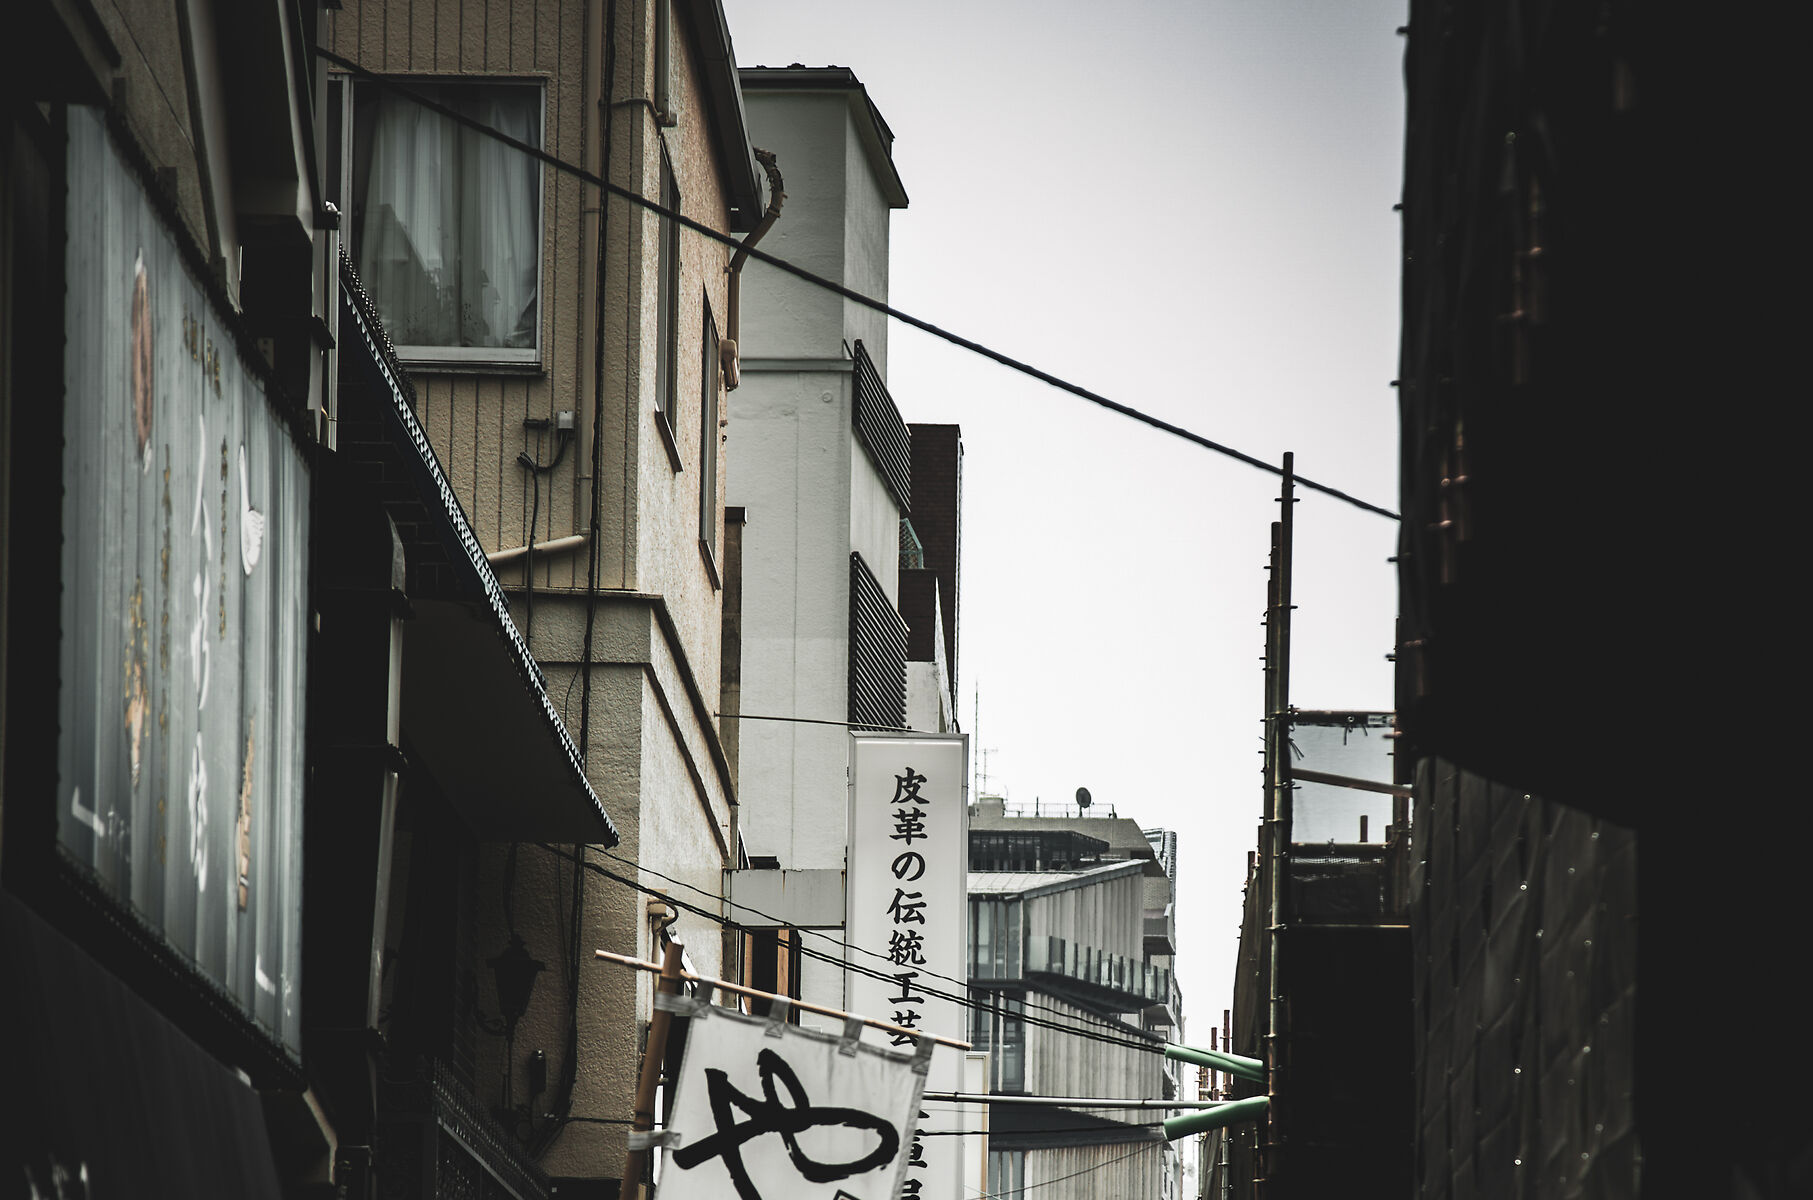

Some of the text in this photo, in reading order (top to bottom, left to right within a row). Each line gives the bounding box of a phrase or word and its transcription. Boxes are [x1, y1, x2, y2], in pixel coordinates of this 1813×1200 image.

[887, 767, 930, 1047] 皮革の伝統工芸
